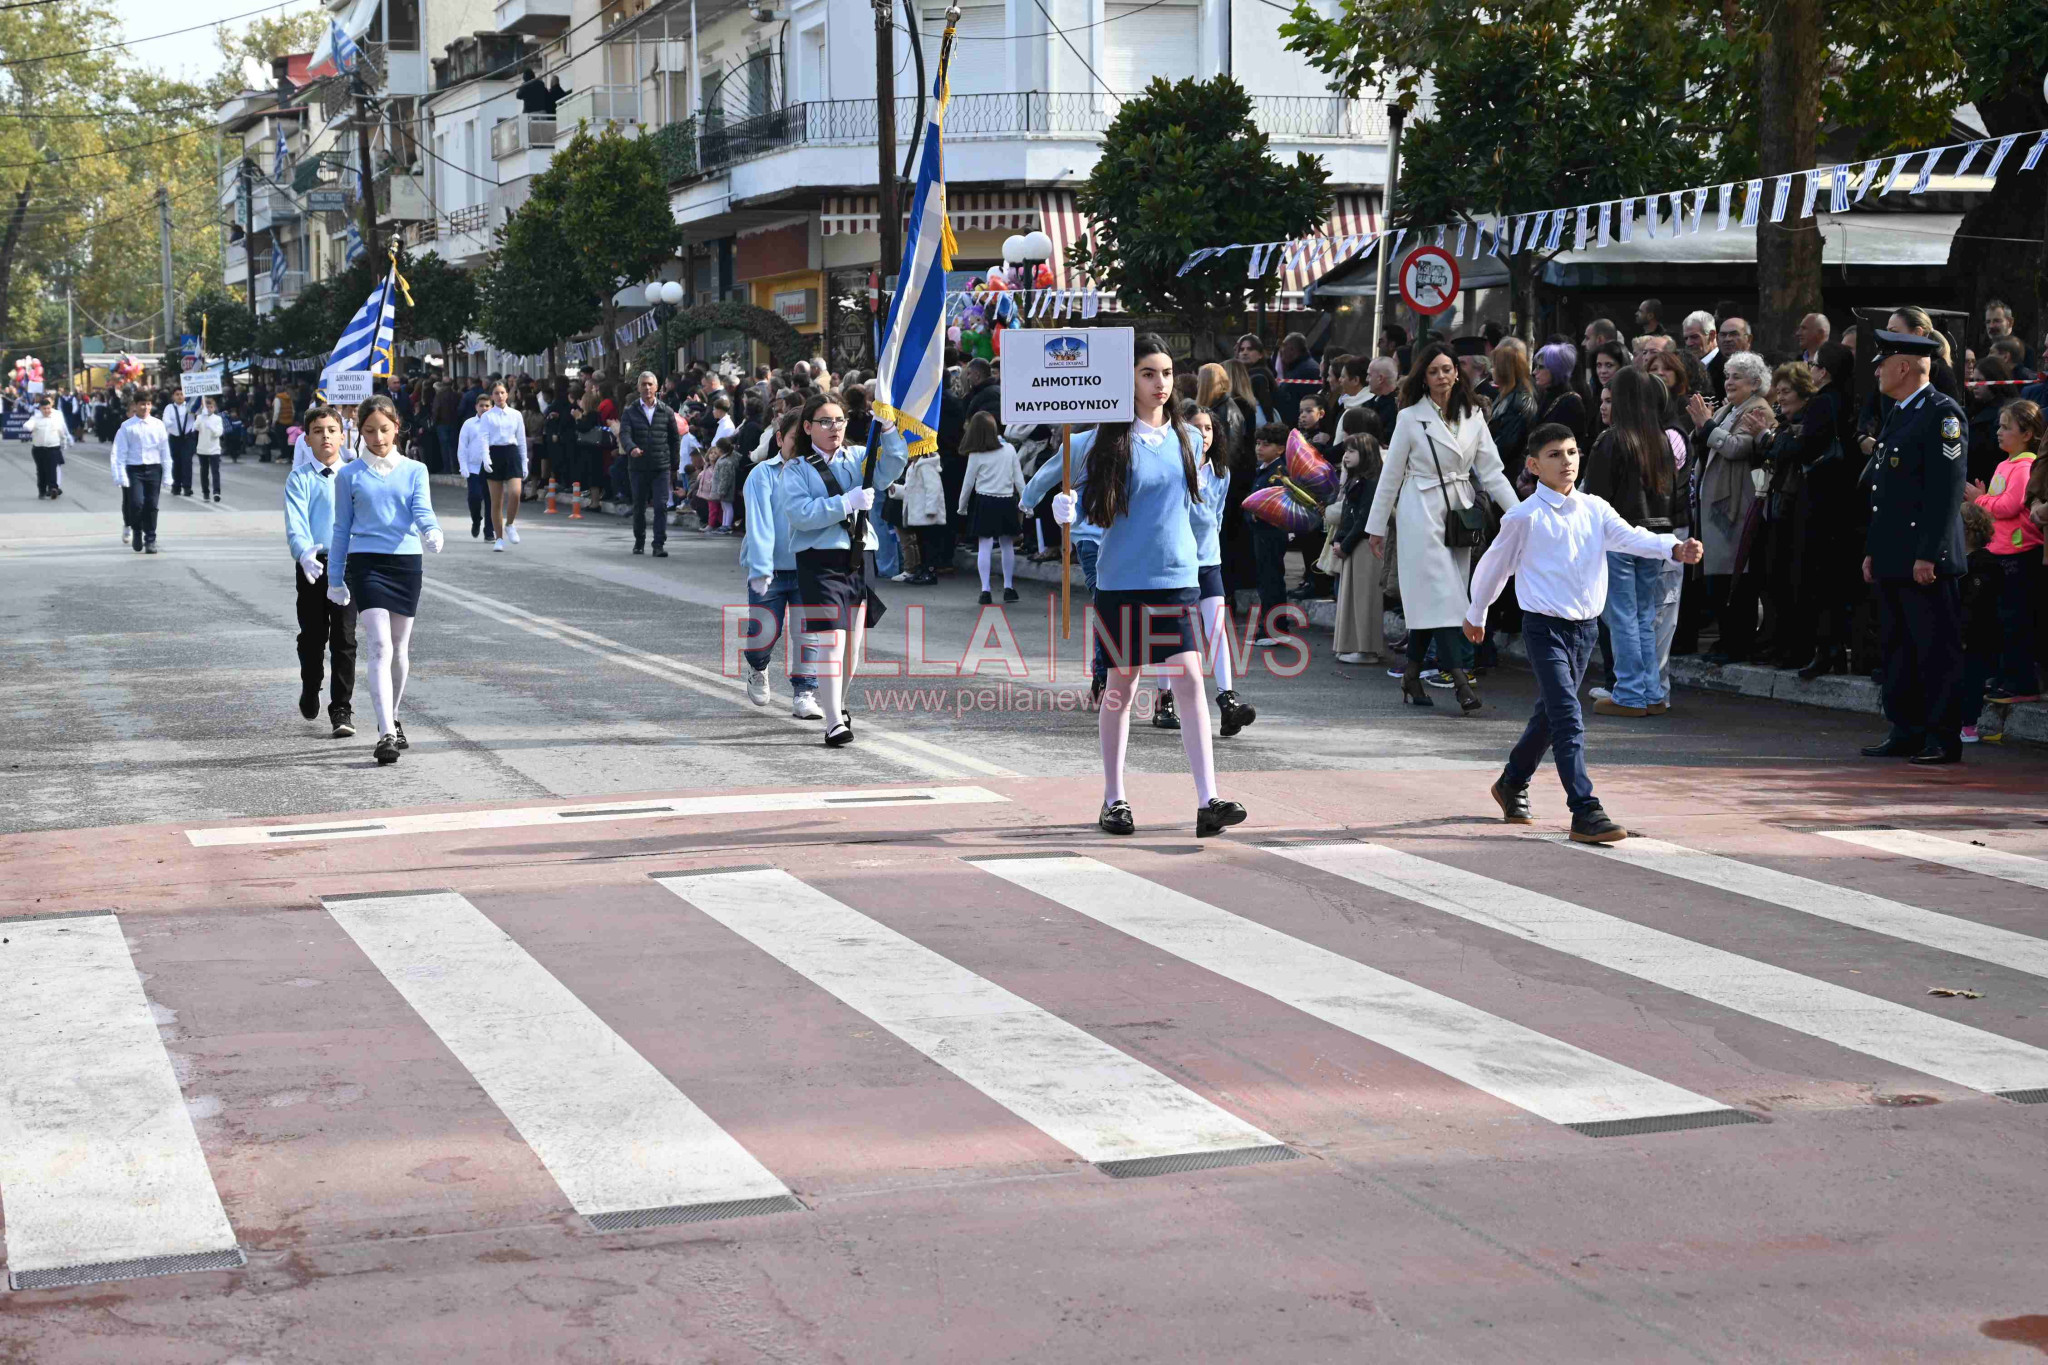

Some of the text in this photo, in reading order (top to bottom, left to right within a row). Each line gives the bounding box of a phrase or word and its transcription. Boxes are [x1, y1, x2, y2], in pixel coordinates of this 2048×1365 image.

[335, 374, 365, 382] ΔΗΜΟΤΙΚΟ
[1031, 375, 1102, 388] ΔΗΜΟΤΙΚΟ
[337, 383, 363, 391] ΣΧΟΛΕΙΟ
[328, 393, 356, 401] ΠΡΟΦΗΤΗ
[1015, 399, 1120, 412] ΜΑΥΡΟΒΟΥΝΙΟΥ
